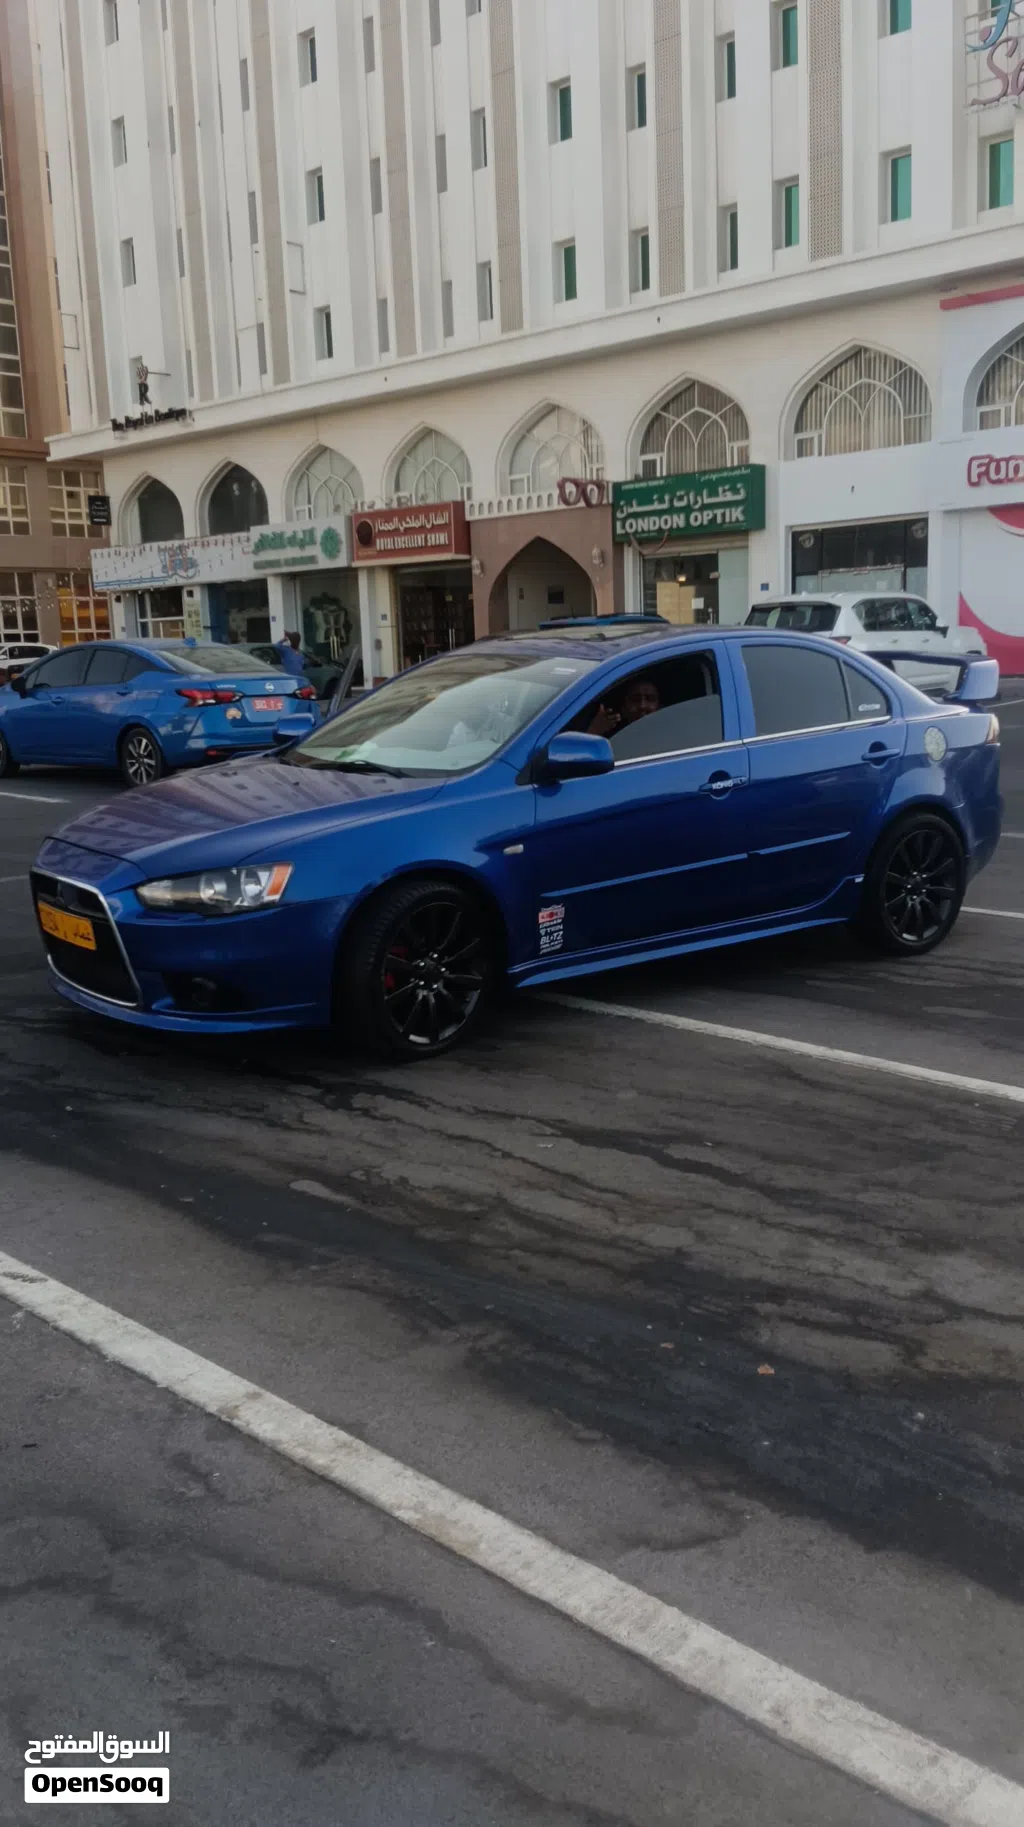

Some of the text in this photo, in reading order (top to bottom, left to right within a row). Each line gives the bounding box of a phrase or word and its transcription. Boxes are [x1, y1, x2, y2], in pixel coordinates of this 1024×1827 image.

[616, 492, 671, 519] لندن
[673, 482, 746, 509] نظارات
[616, 505, 745, 535] LONDON OPTIK
